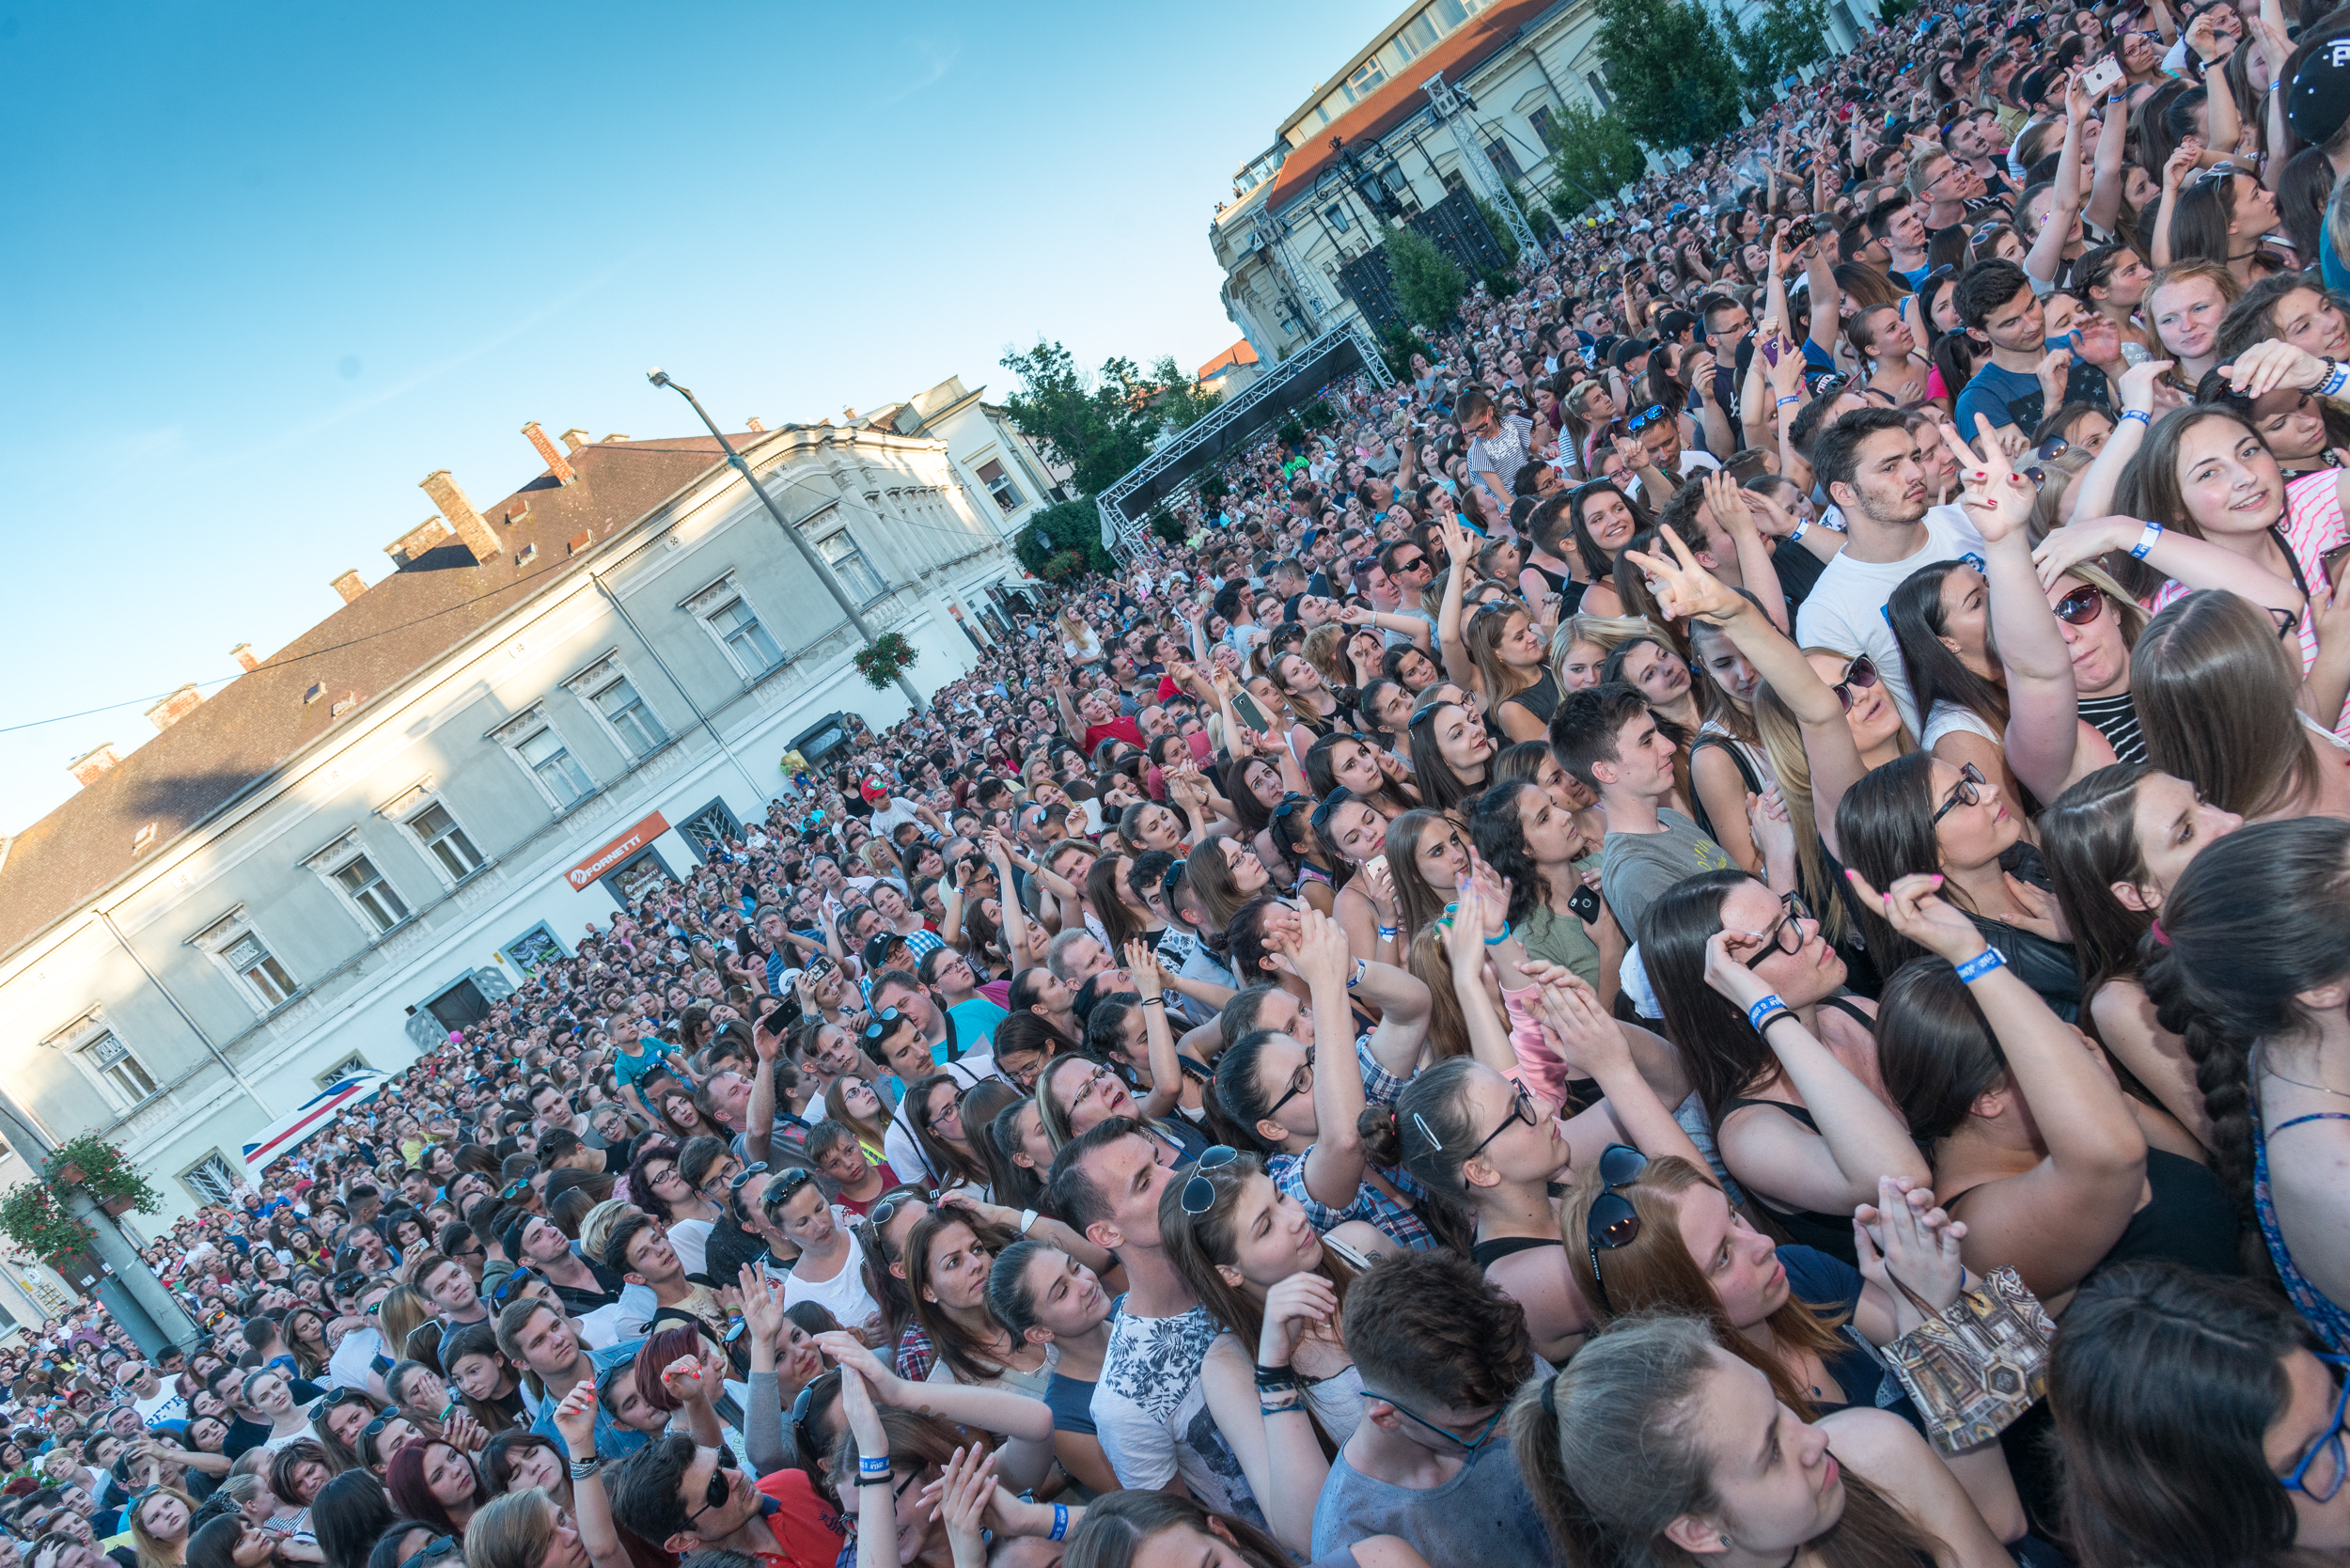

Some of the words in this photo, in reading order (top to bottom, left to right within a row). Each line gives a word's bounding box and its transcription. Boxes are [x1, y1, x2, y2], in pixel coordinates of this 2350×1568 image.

[585, 834, 642, 878] FORNETTI
[632, 869, 659, 888] FORNETTI
[808, 964, 825, 980] 23
